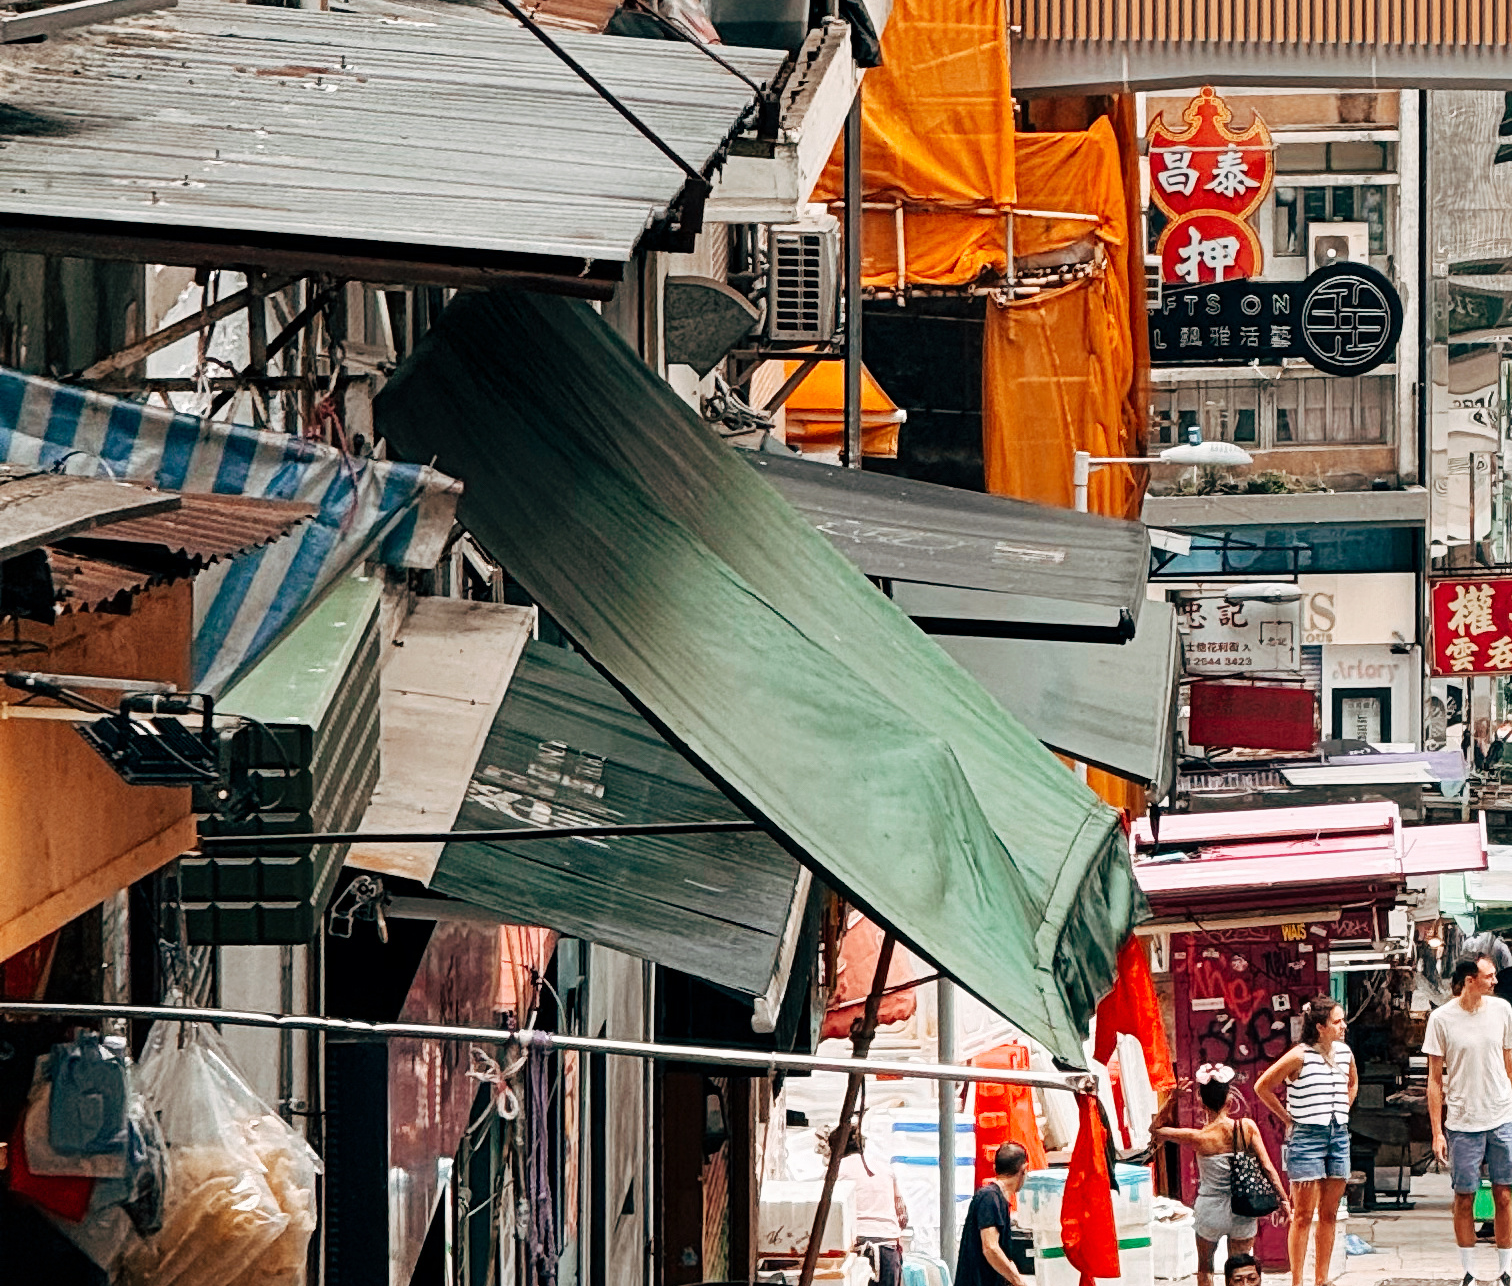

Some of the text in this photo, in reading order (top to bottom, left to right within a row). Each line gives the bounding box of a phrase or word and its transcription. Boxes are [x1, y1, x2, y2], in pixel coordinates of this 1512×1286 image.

[1174, 226, 1240, 282] 押
[1151, 293, 1291, 316] FTS ON
